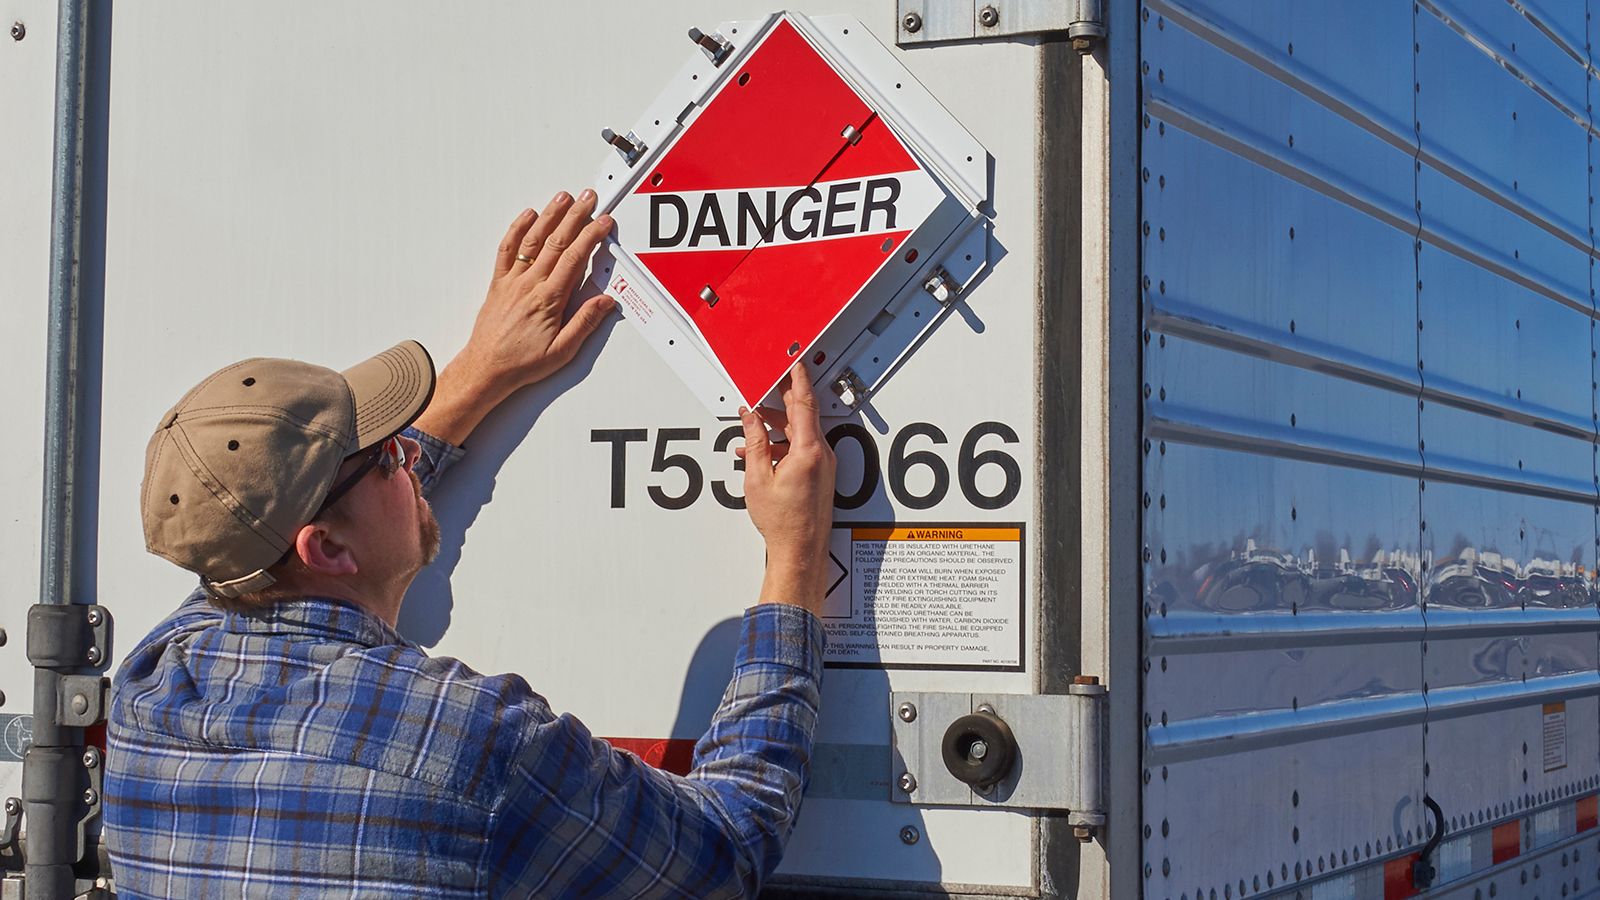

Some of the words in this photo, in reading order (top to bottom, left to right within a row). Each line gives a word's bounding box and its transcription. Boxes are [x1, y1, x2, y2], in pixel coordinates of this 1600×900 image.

[649, 177, 901, 248] DANGER
[590, 421, 1021, 510] T53066
[916, 531, 963, 539] WARNING
